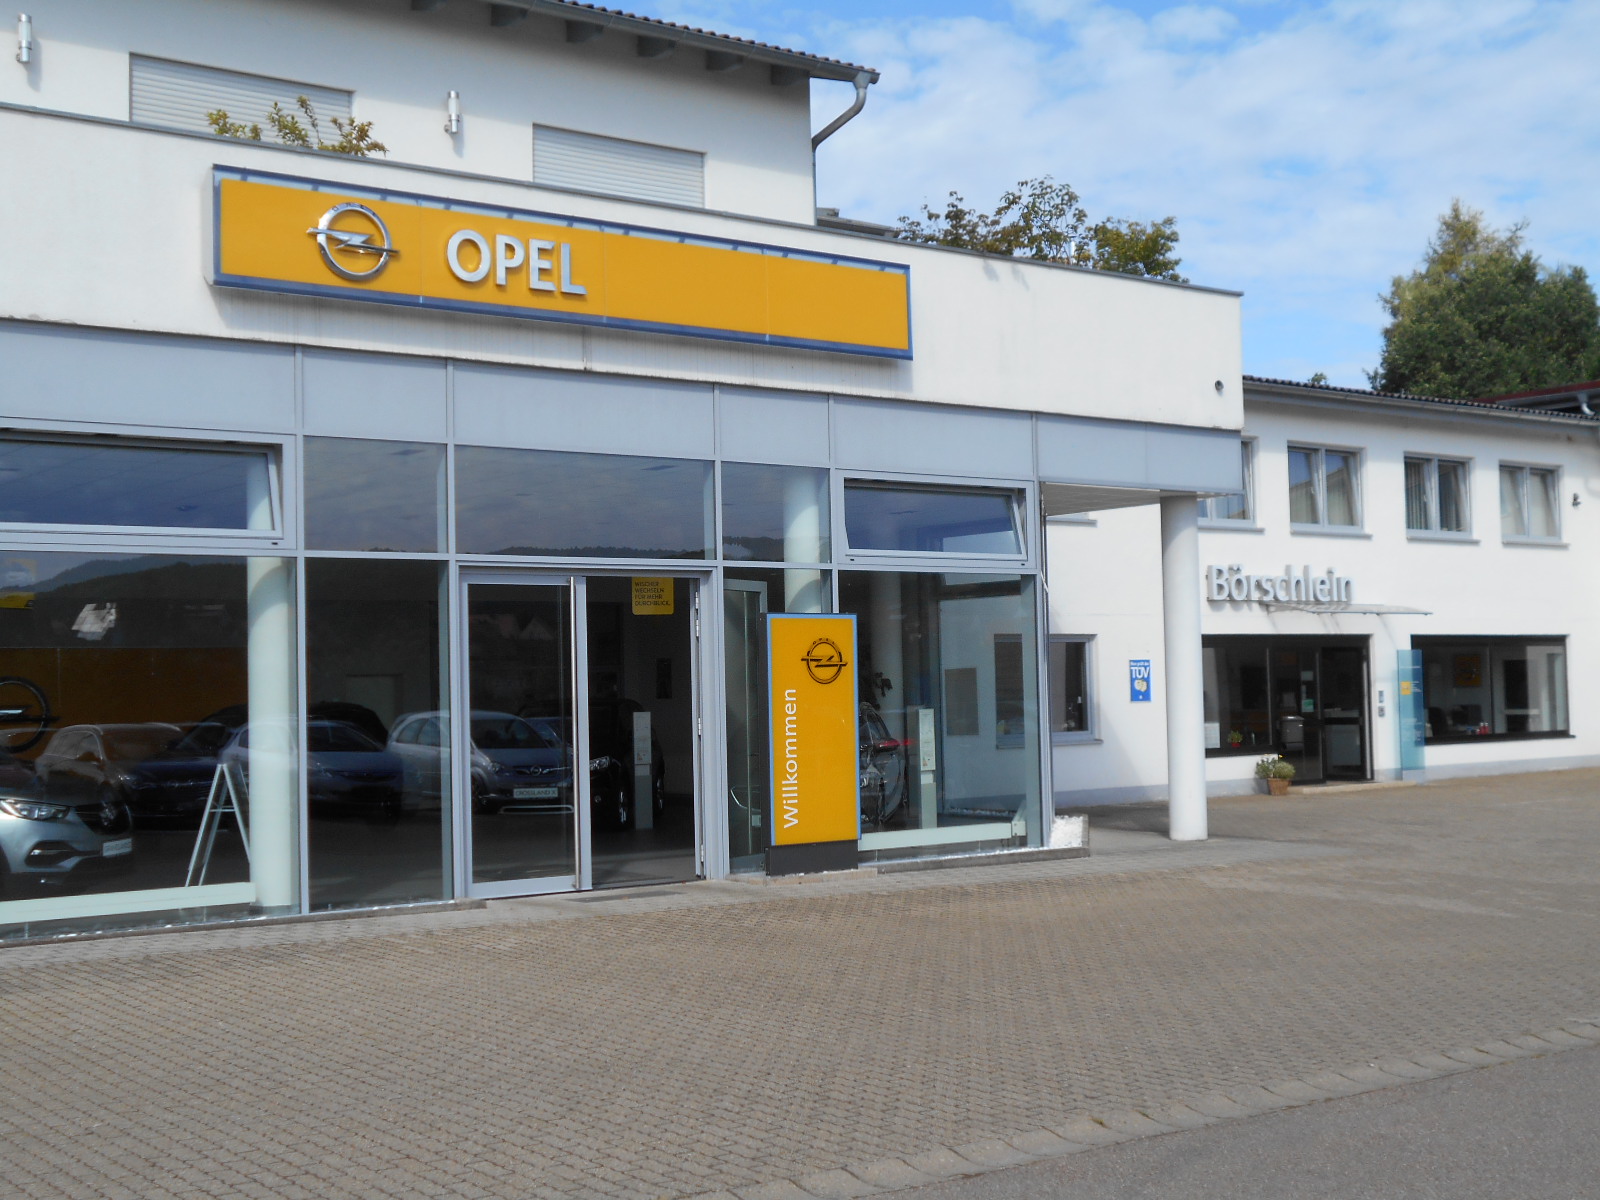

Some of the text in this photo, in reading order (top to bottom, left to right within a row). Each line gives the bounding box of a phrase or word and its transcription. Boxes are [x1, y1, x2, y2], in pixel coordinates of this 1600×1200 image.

[447, 229, 588, 295] OPEL
[1206, 564, 1354, 602] Börschlein
[1130, 666, 1150, 679] TÜV
[782, 689, 799, 829] Willkommen
